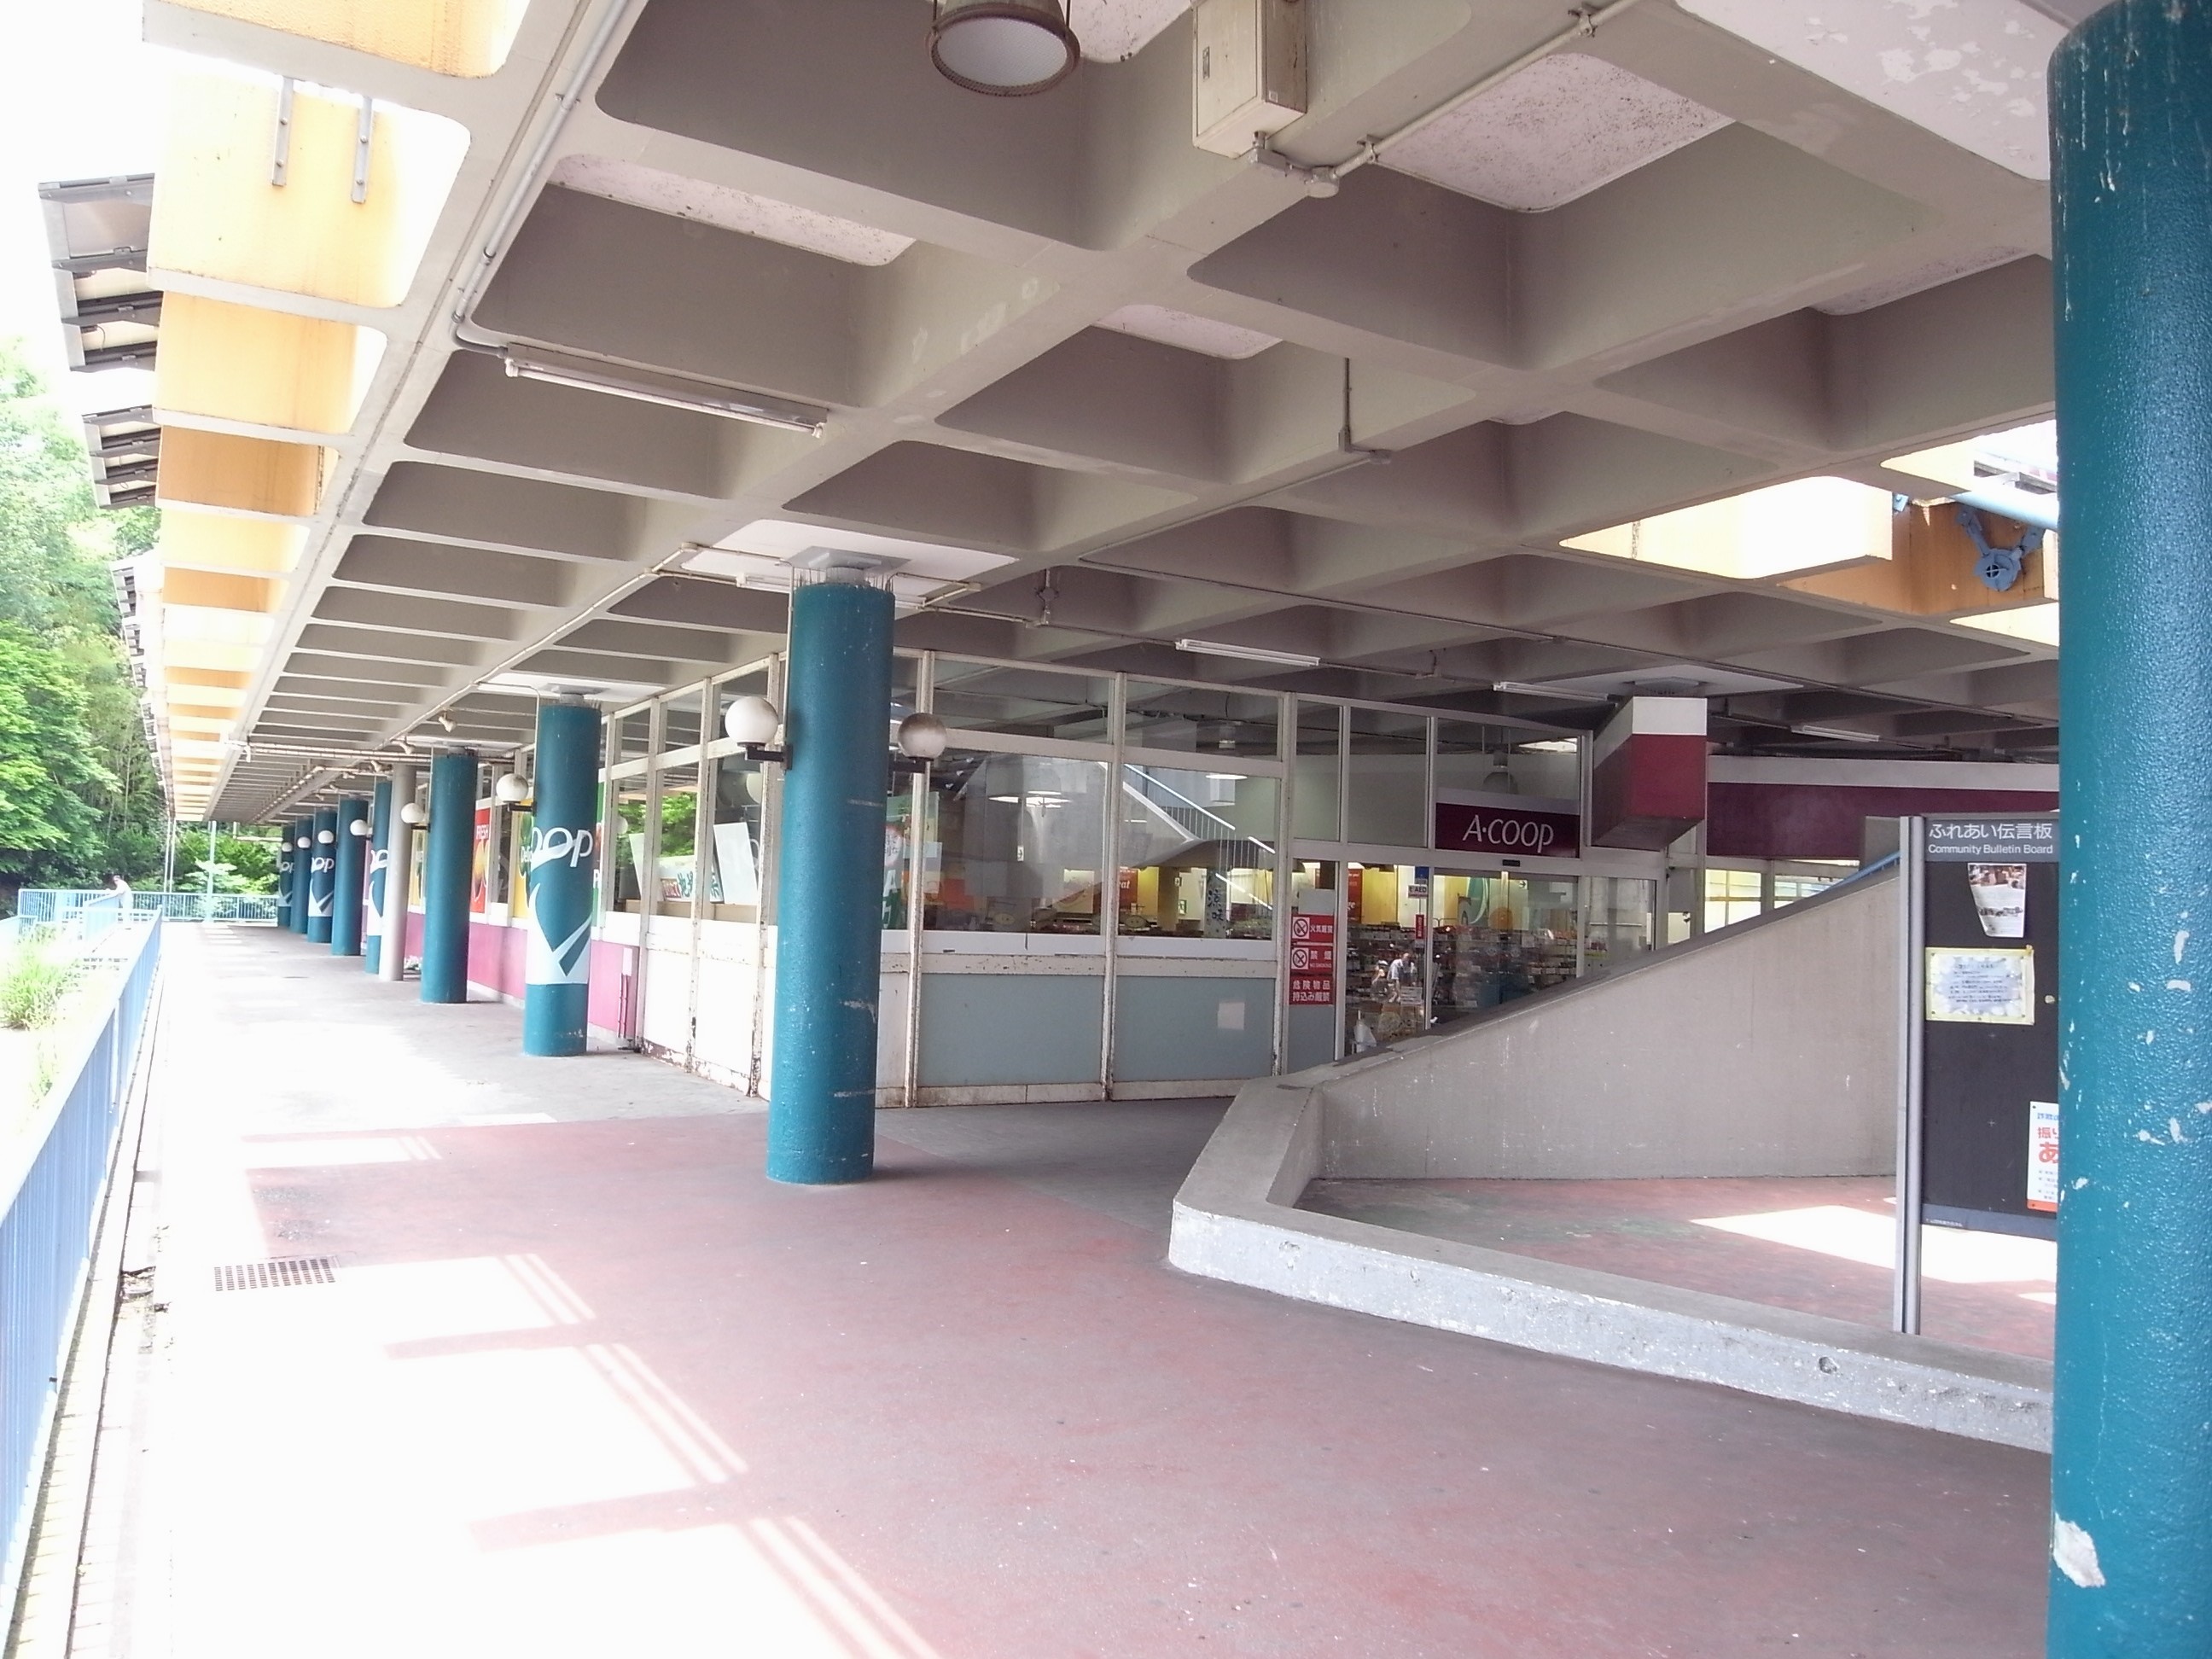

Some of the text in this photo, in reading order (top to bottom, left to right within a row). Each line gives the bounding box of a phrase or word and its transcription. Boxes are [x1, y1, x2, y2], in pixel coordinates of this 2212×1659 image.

[1929, 822, 2053, 840] ふれあい伝言板
[1928, 844, 2053, 855] Community Bulletin Board
[1292, 980, 1330, 990] 危険物品
[1292, 991, 1330, 1002] 持込み厳禁
